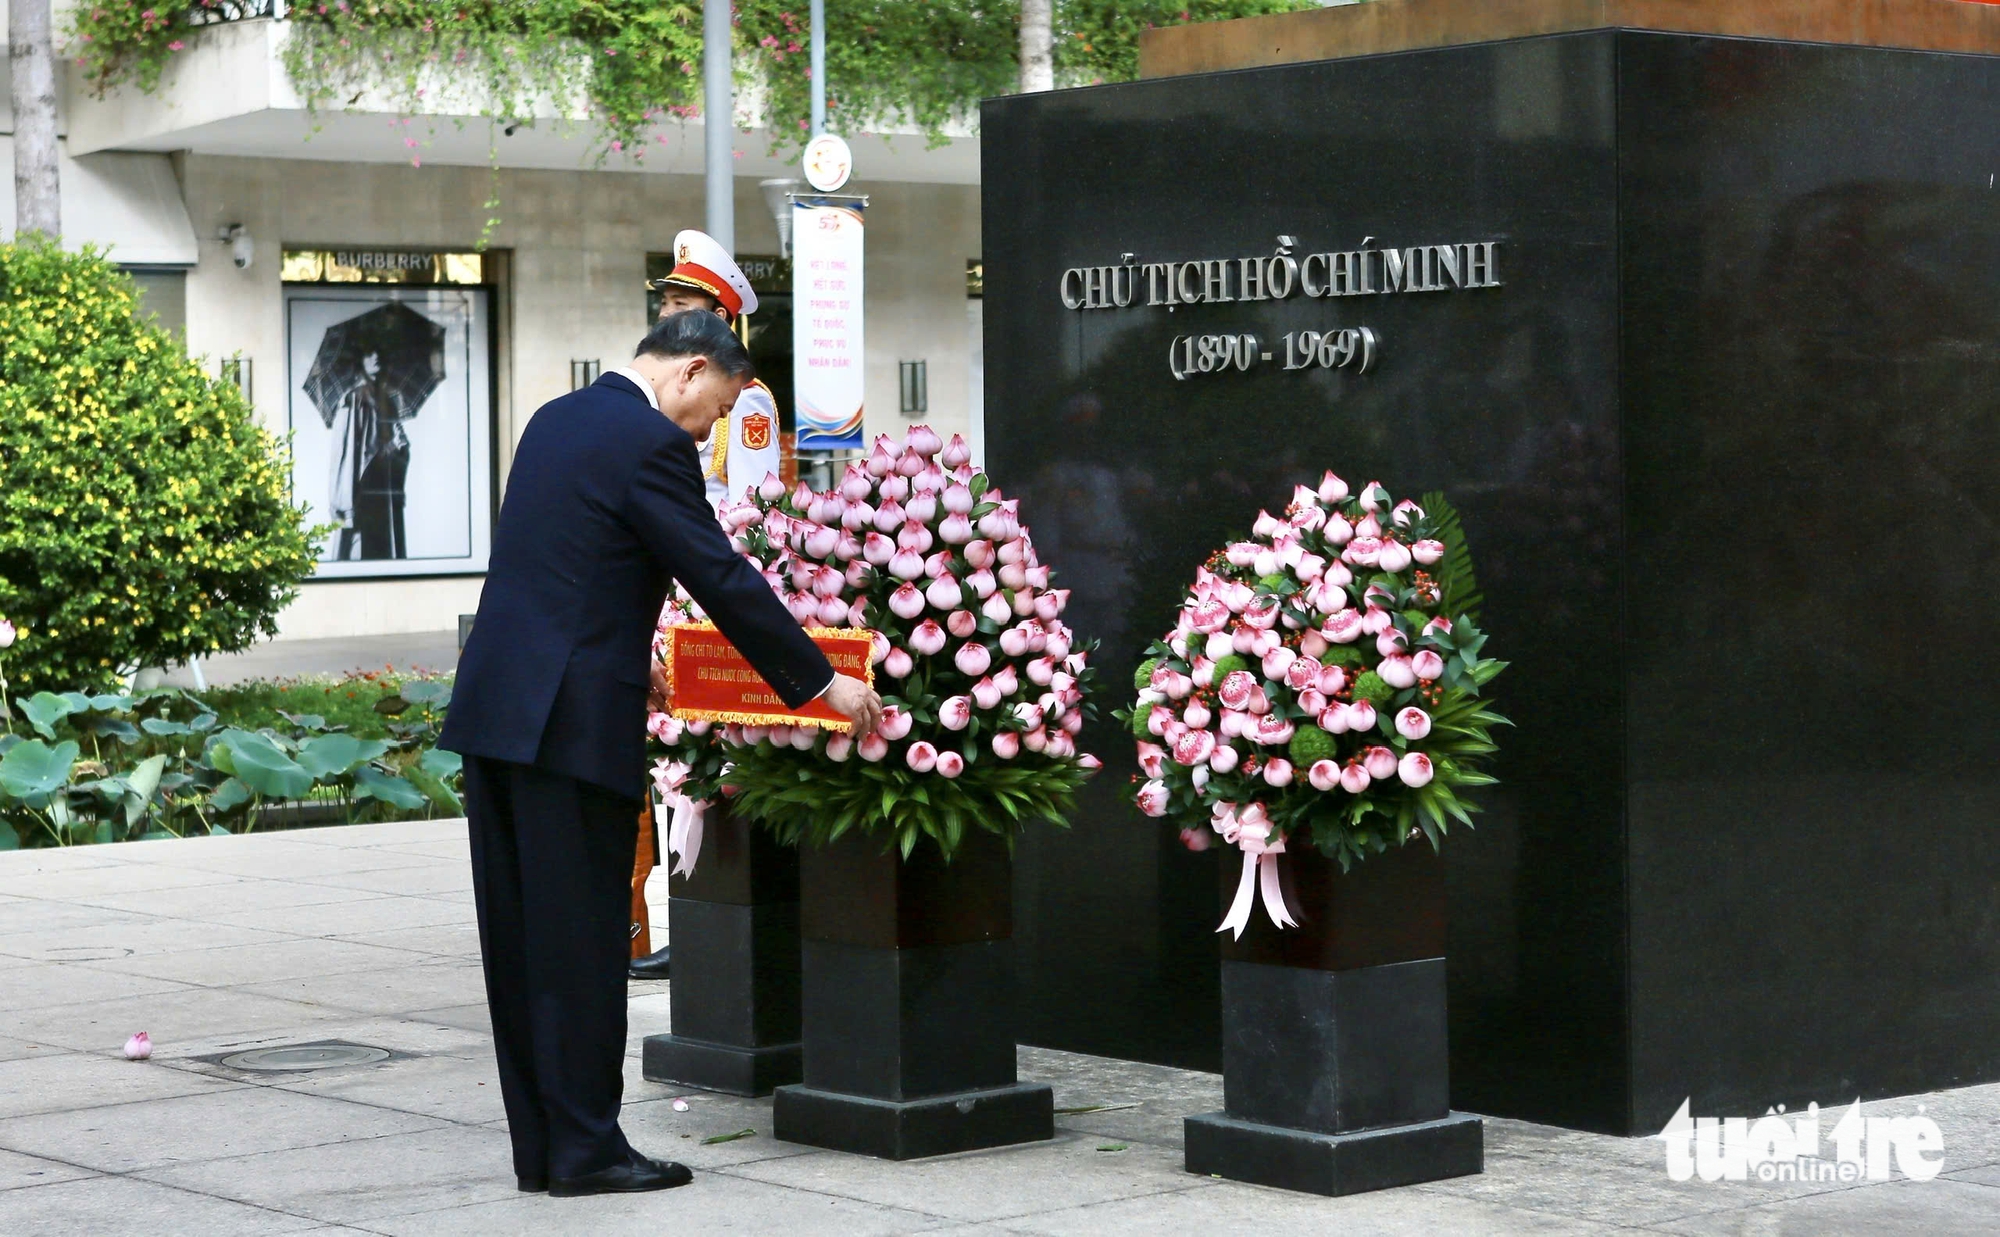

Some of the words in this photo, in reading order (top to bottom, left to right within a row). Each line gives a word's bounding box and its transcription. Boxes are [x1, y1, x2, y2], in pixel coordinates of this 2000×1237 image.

[337, 252, 433, 269] BURBERRY
[1060, 252, 1136, 310] CHỦ
[1142, 259, 1237, 313] TỊCH
[1238, 235, 1300, 301] HỒ
[1301, 236, 1380, 297] CHÍ
[1381, 242, 1503, 294] MINH
[1169, 333, 1258, 381] (1890
[1282, 326, 1379, 375] 1969)
